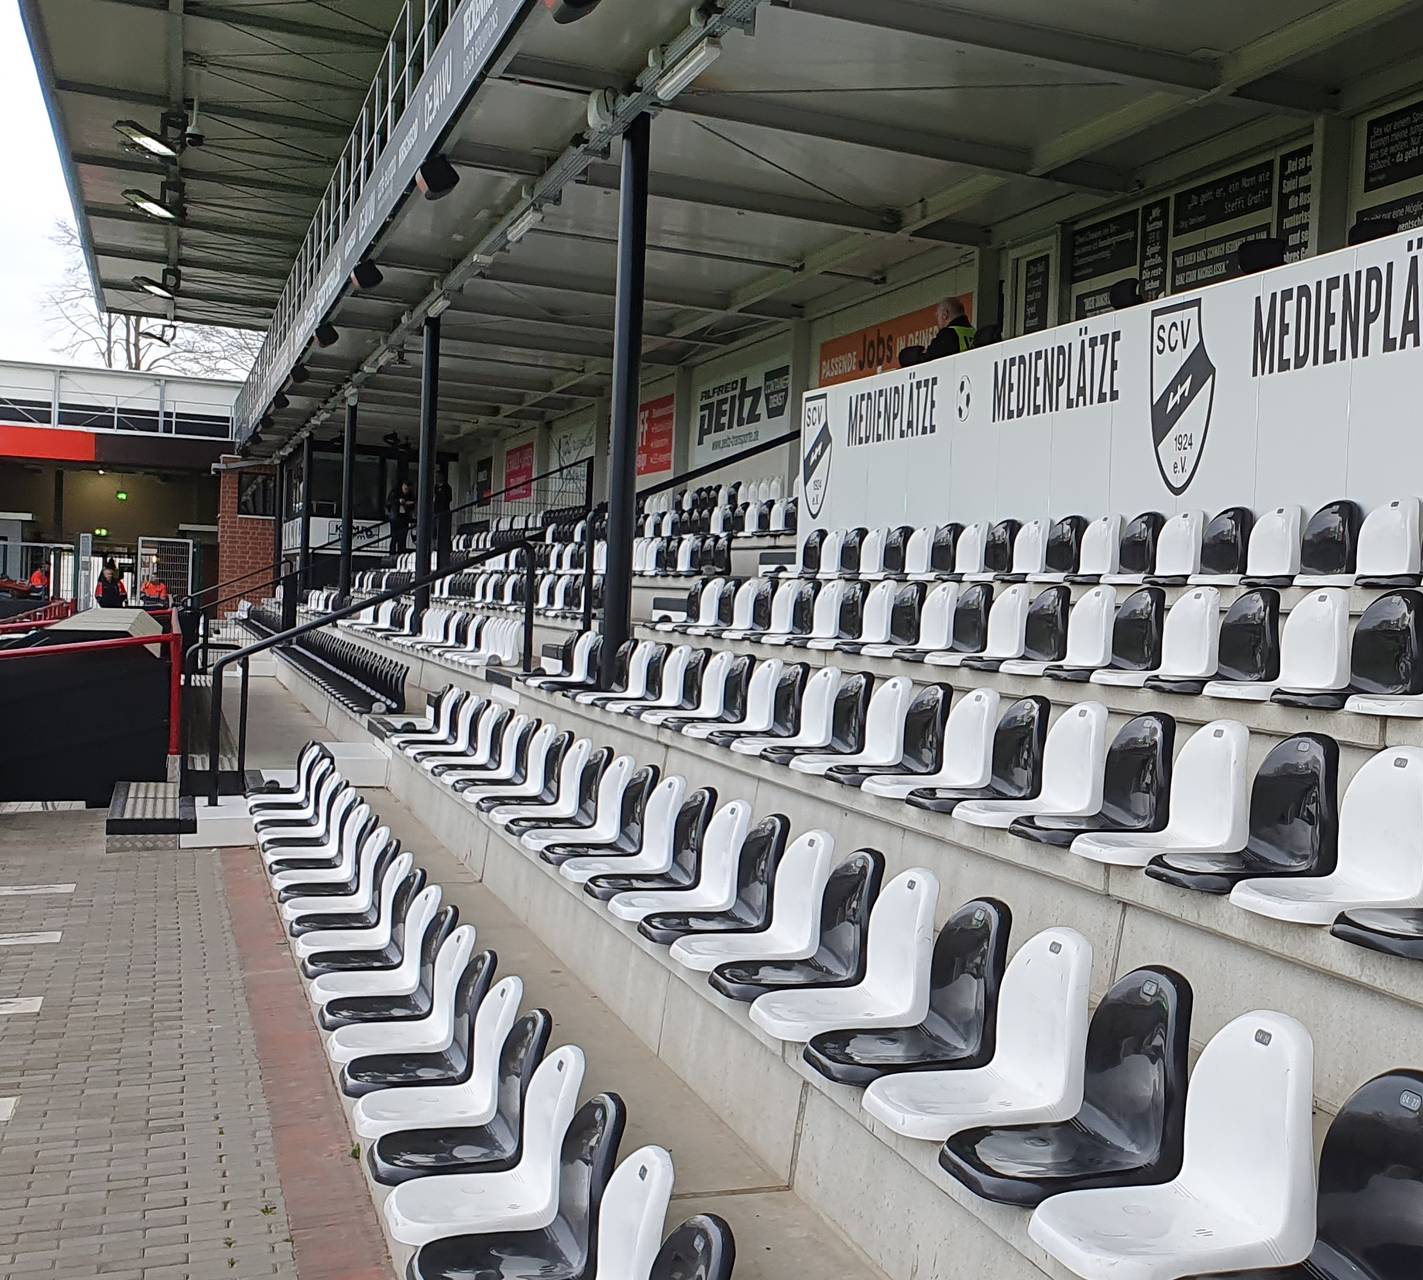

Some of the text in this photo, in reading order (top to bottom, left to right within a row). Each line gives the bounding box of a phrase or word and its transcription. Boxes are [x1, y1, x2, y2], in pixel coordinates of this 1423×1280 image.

[822, 352, 857, 379] PASSENDE
[859, 329, 893, 371] Jobs
[1156, 318, 1191, 355] SCV
[992, 326, 1120, 423] MEDIENPLÄTZE
[807, 405, 823, 428] SCV
[847, 372, 938, 447] MEDIENPLÄTZE
[1174, 432, 1193, 451] 1924
